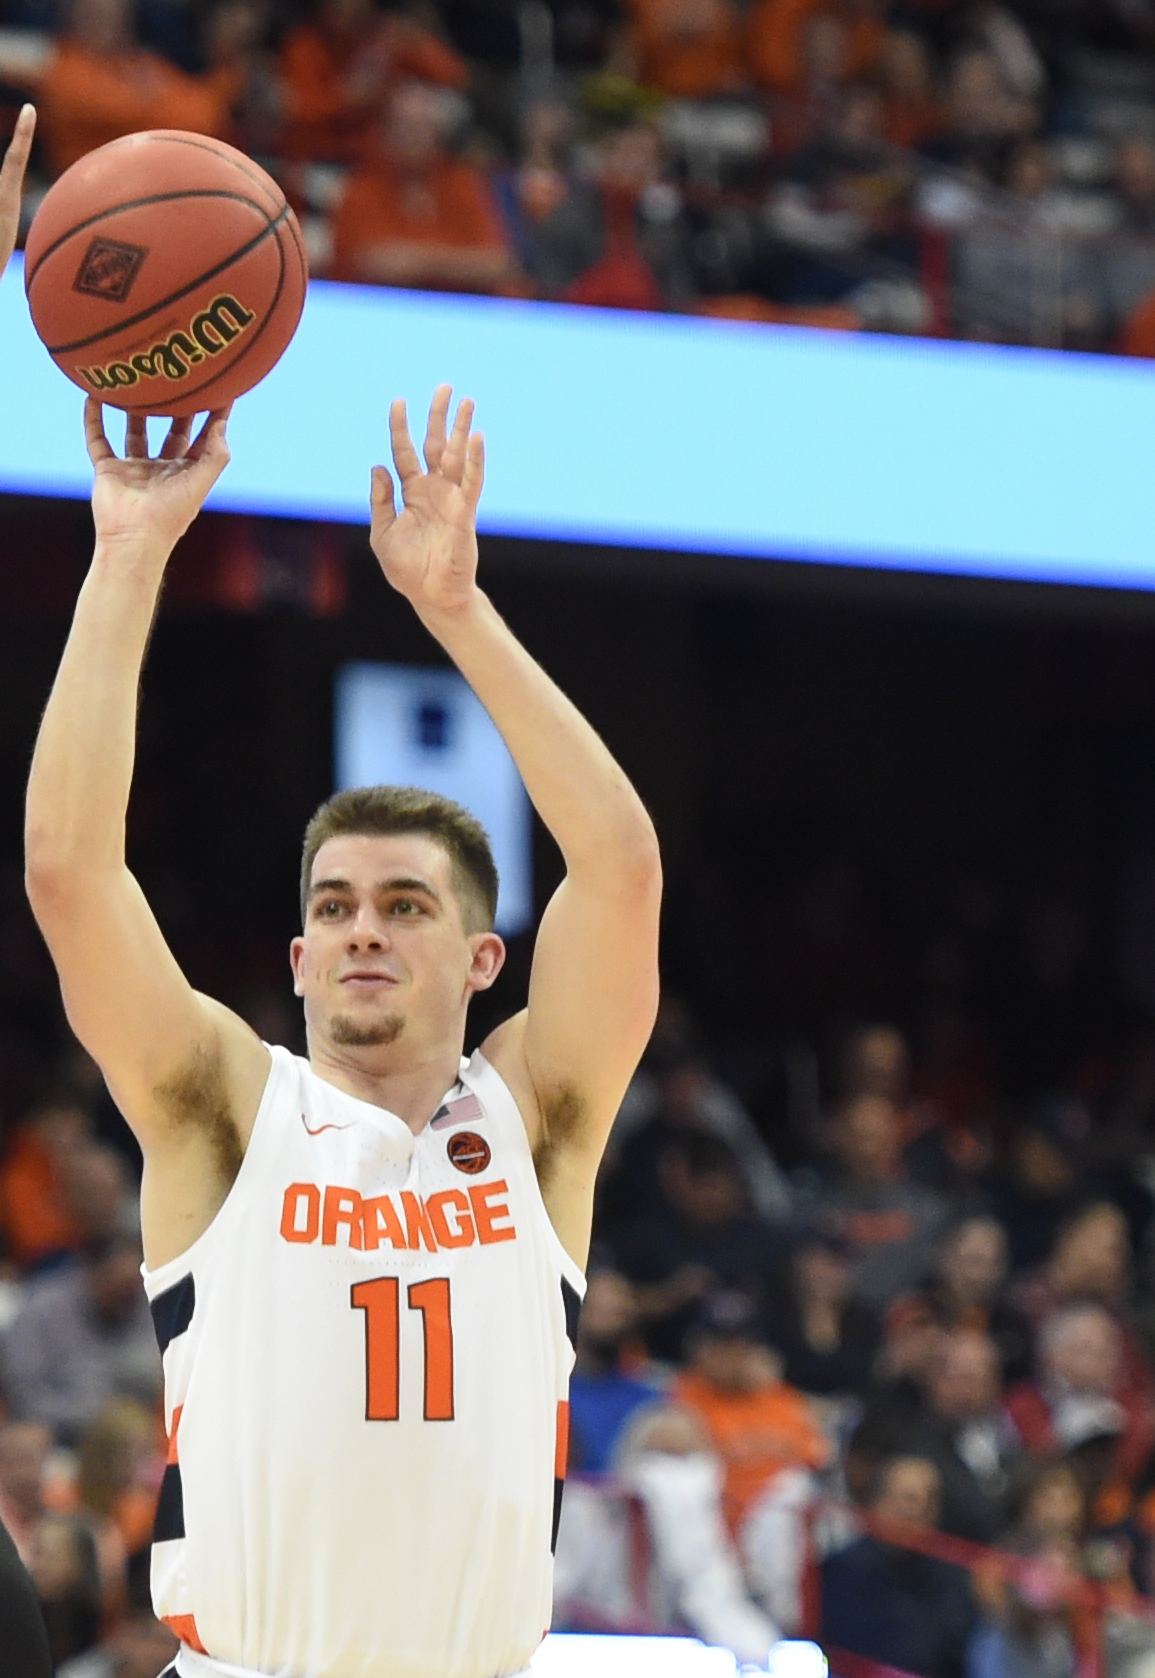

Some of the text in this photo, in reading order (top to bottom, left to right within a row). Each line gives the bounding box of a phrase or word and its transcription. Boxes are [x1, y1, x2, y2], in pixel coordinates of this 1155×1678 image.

[75, 294, 256, 390] Wilson
[280, 1179, 517, 1253] ORANGE
[350, 1276, 455, 1421] 11
